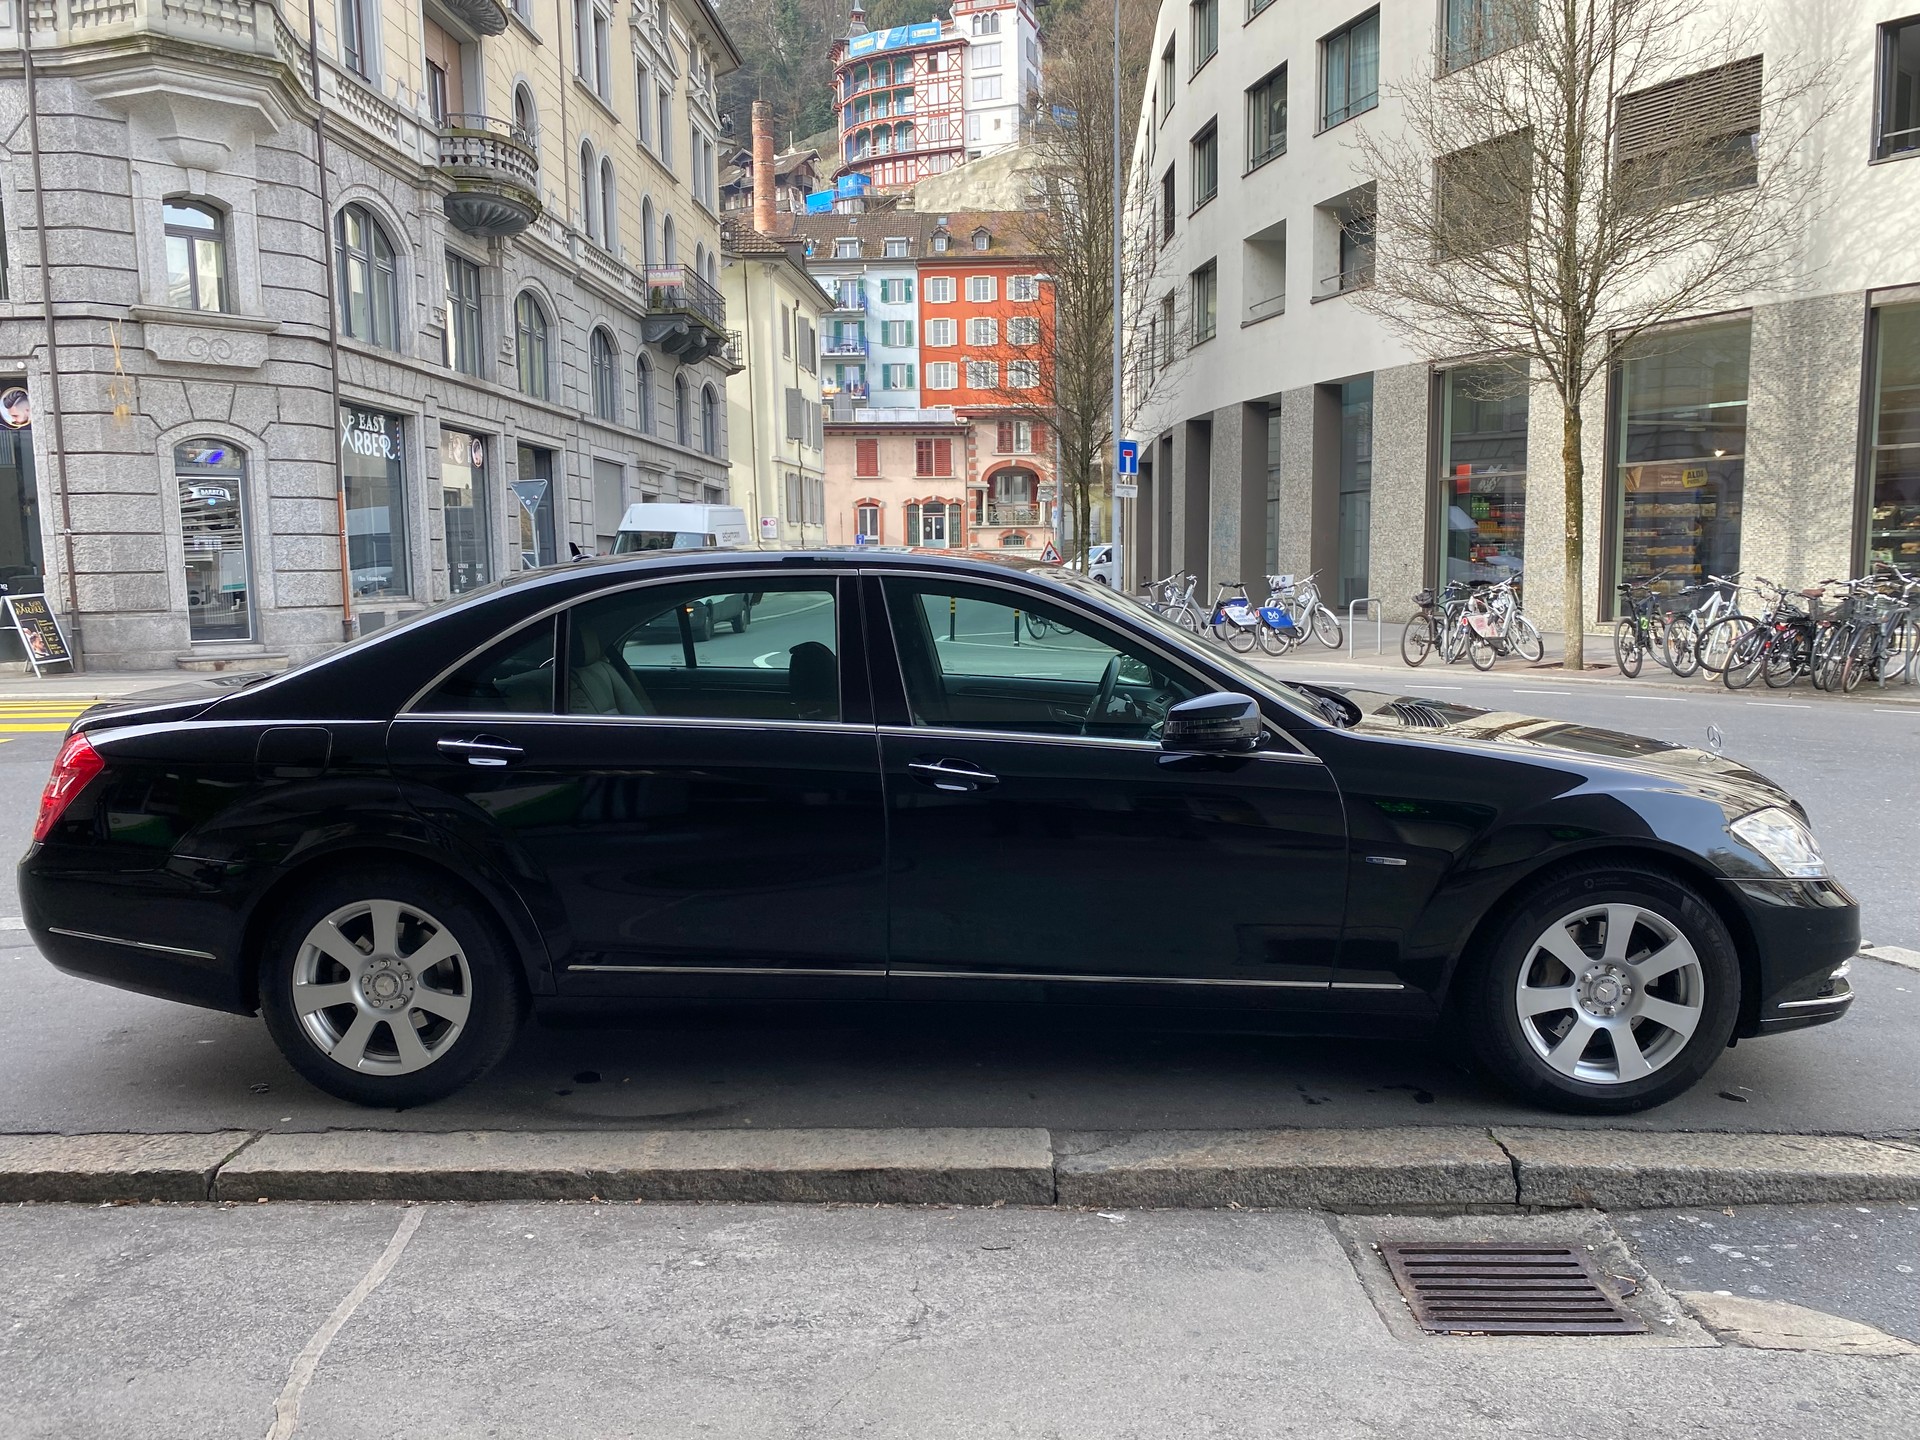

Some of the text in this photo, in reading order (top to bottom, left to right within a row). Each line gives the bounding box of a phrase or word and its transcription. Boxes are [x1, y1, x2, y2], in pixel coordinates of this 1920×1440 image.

[358, 413, 386, 434] EASY
[1686, 470, 1704, 479] ALDI
[200, 488, 225, 497] BARBER
